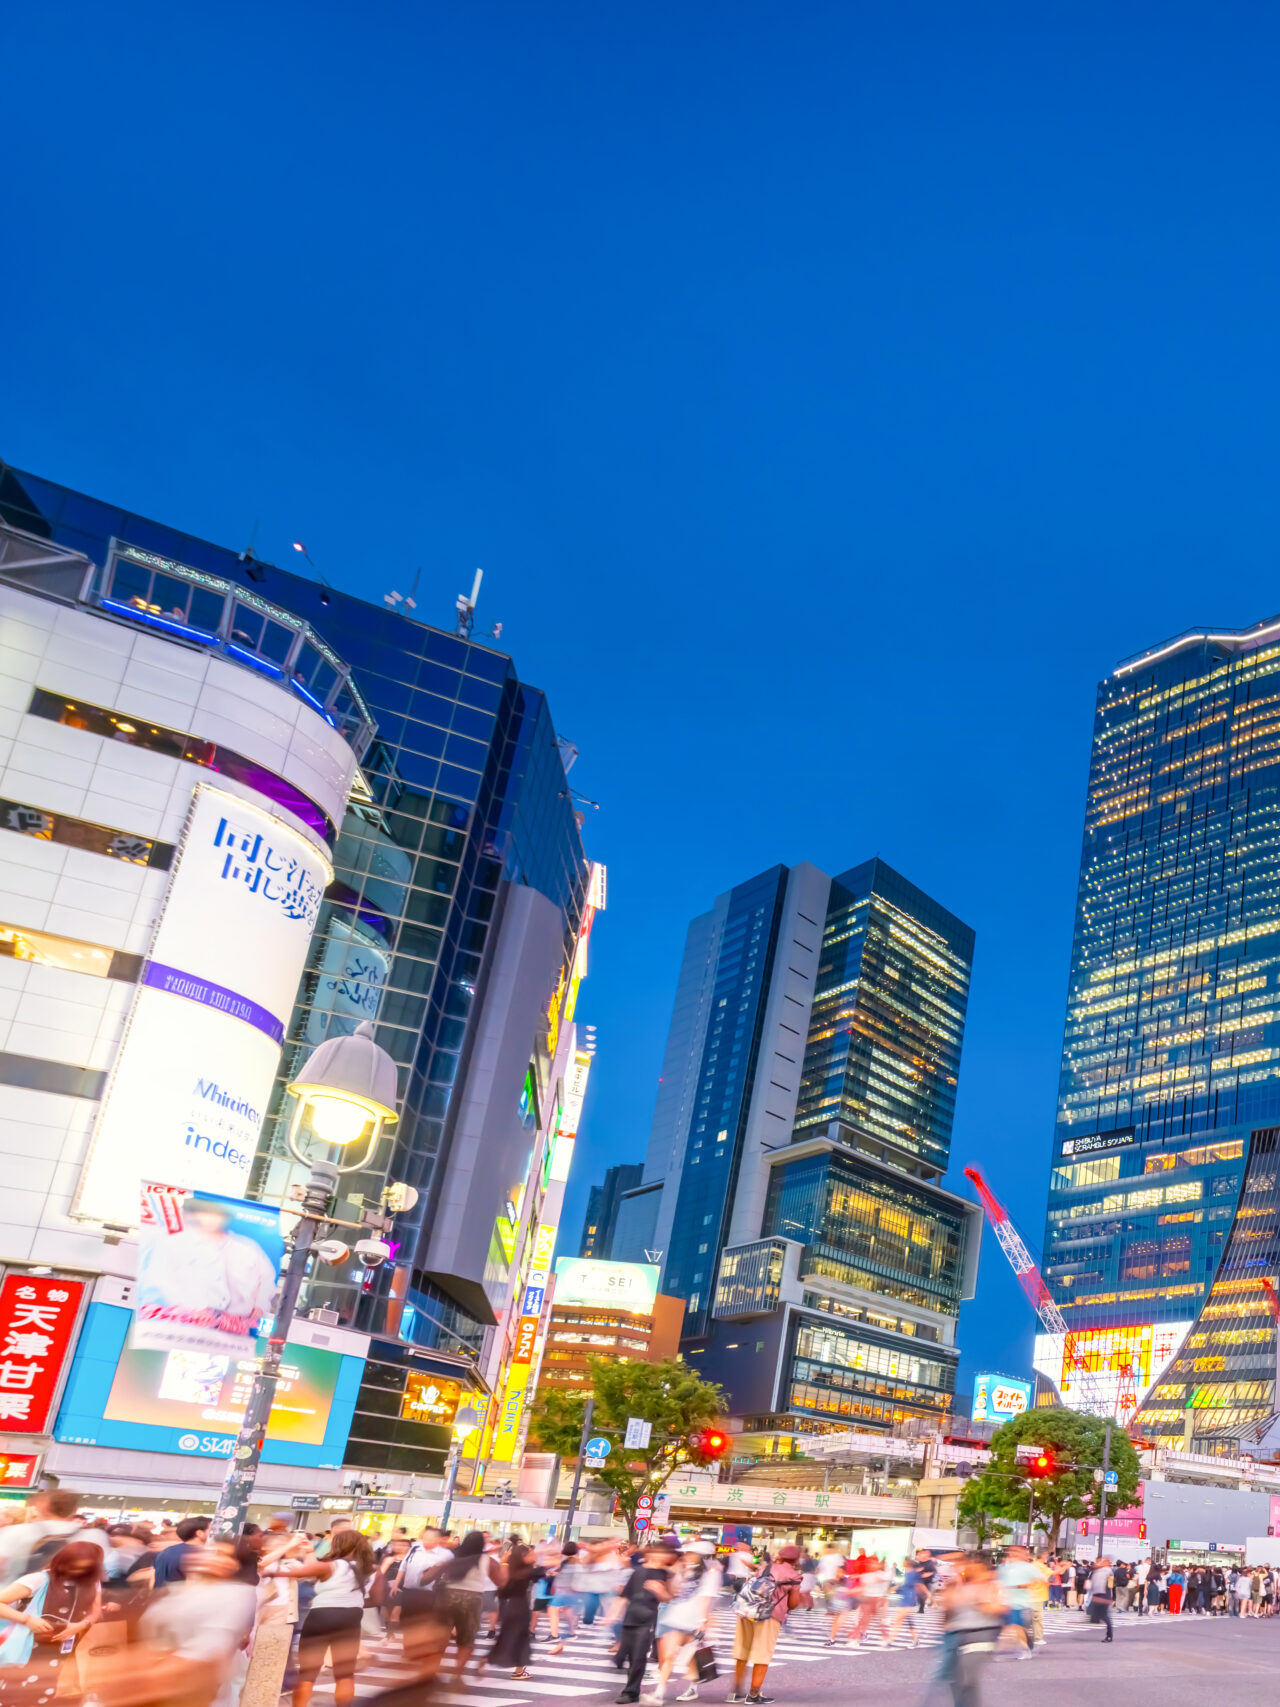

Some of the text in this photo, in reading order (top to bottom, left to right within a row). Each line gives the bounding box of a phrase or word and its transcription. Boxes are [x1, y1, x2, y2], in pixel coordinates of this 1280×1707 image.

[185, 1126, 250, 1172] indee
[1074, 1135, 1134, 1152] SCRAMBLE SQUARE
[1075, 1135, 1102, 1146] SHIBUYA
[15, 1286, 69, 1302] 名物
[0, 1303, 61, 1420] 天津甘栗
[502, 1390, 522, 1433] プロミス
[679, 1486, 697, 1495] JR
